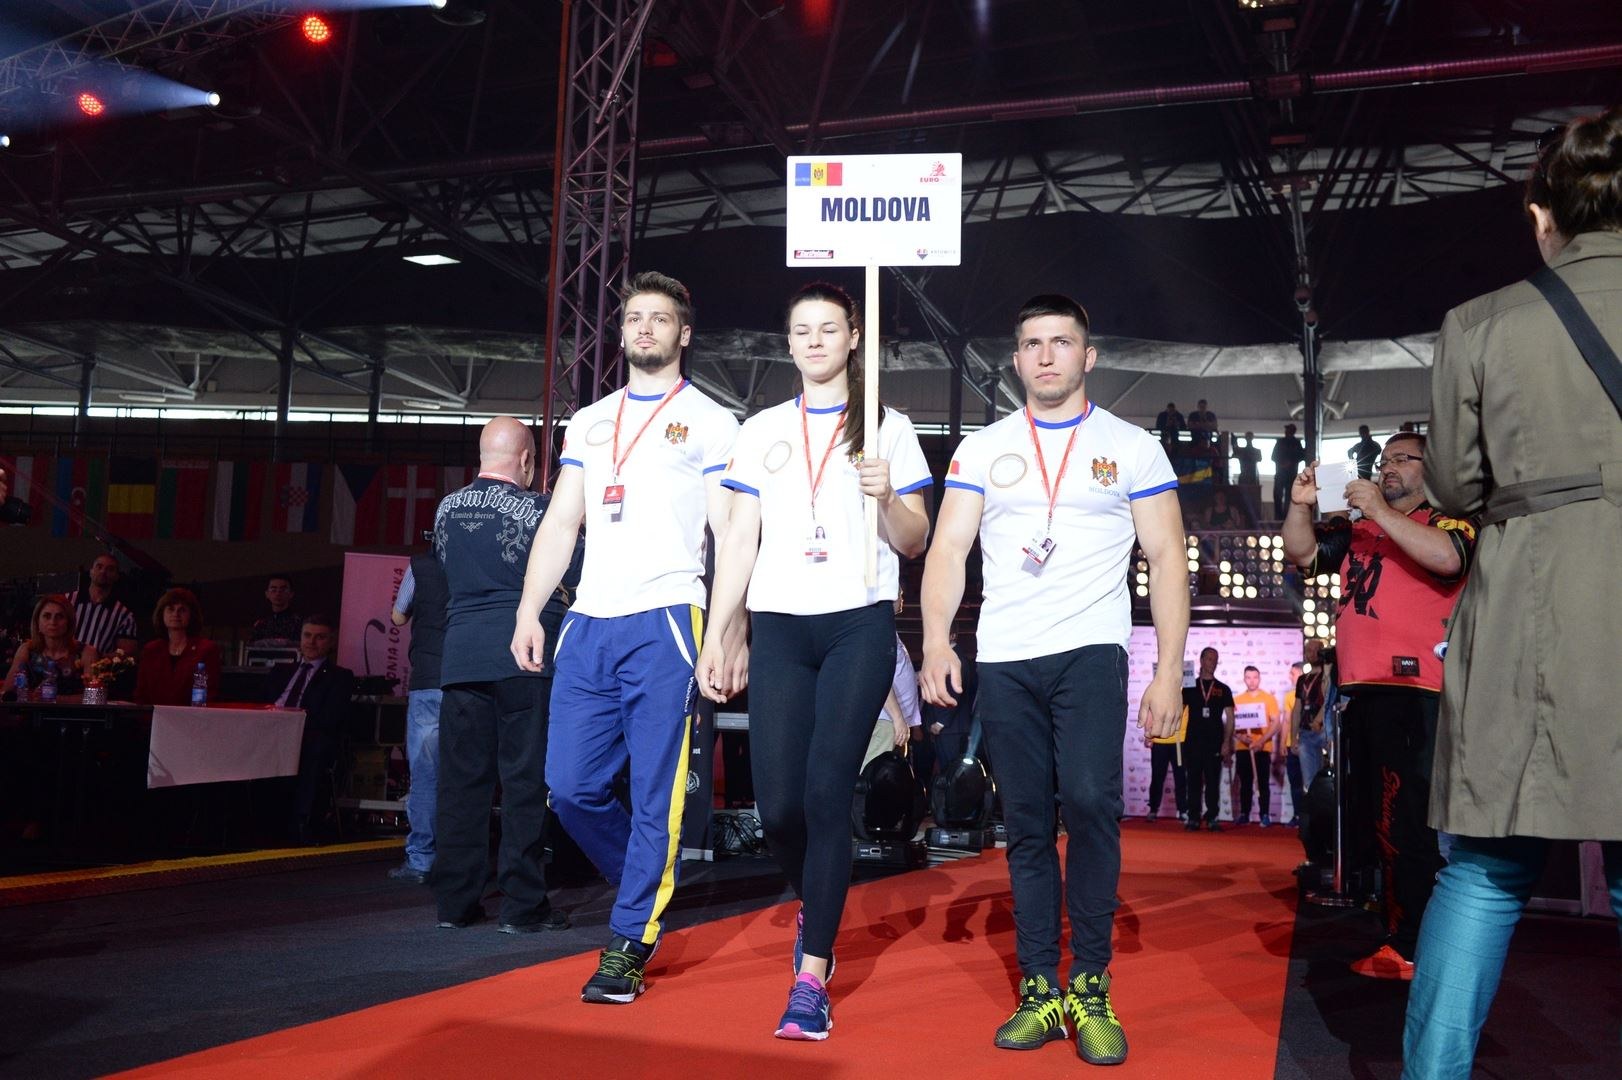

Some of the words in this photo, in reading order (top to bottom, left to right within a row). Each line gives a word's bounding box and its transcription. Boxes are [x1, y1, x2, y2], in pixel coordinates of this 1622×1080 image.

[821, 197, 931, 222] MOLDOVA
[450, 511, 473, 519] Limited
[474, 511, 496, 520] Series
